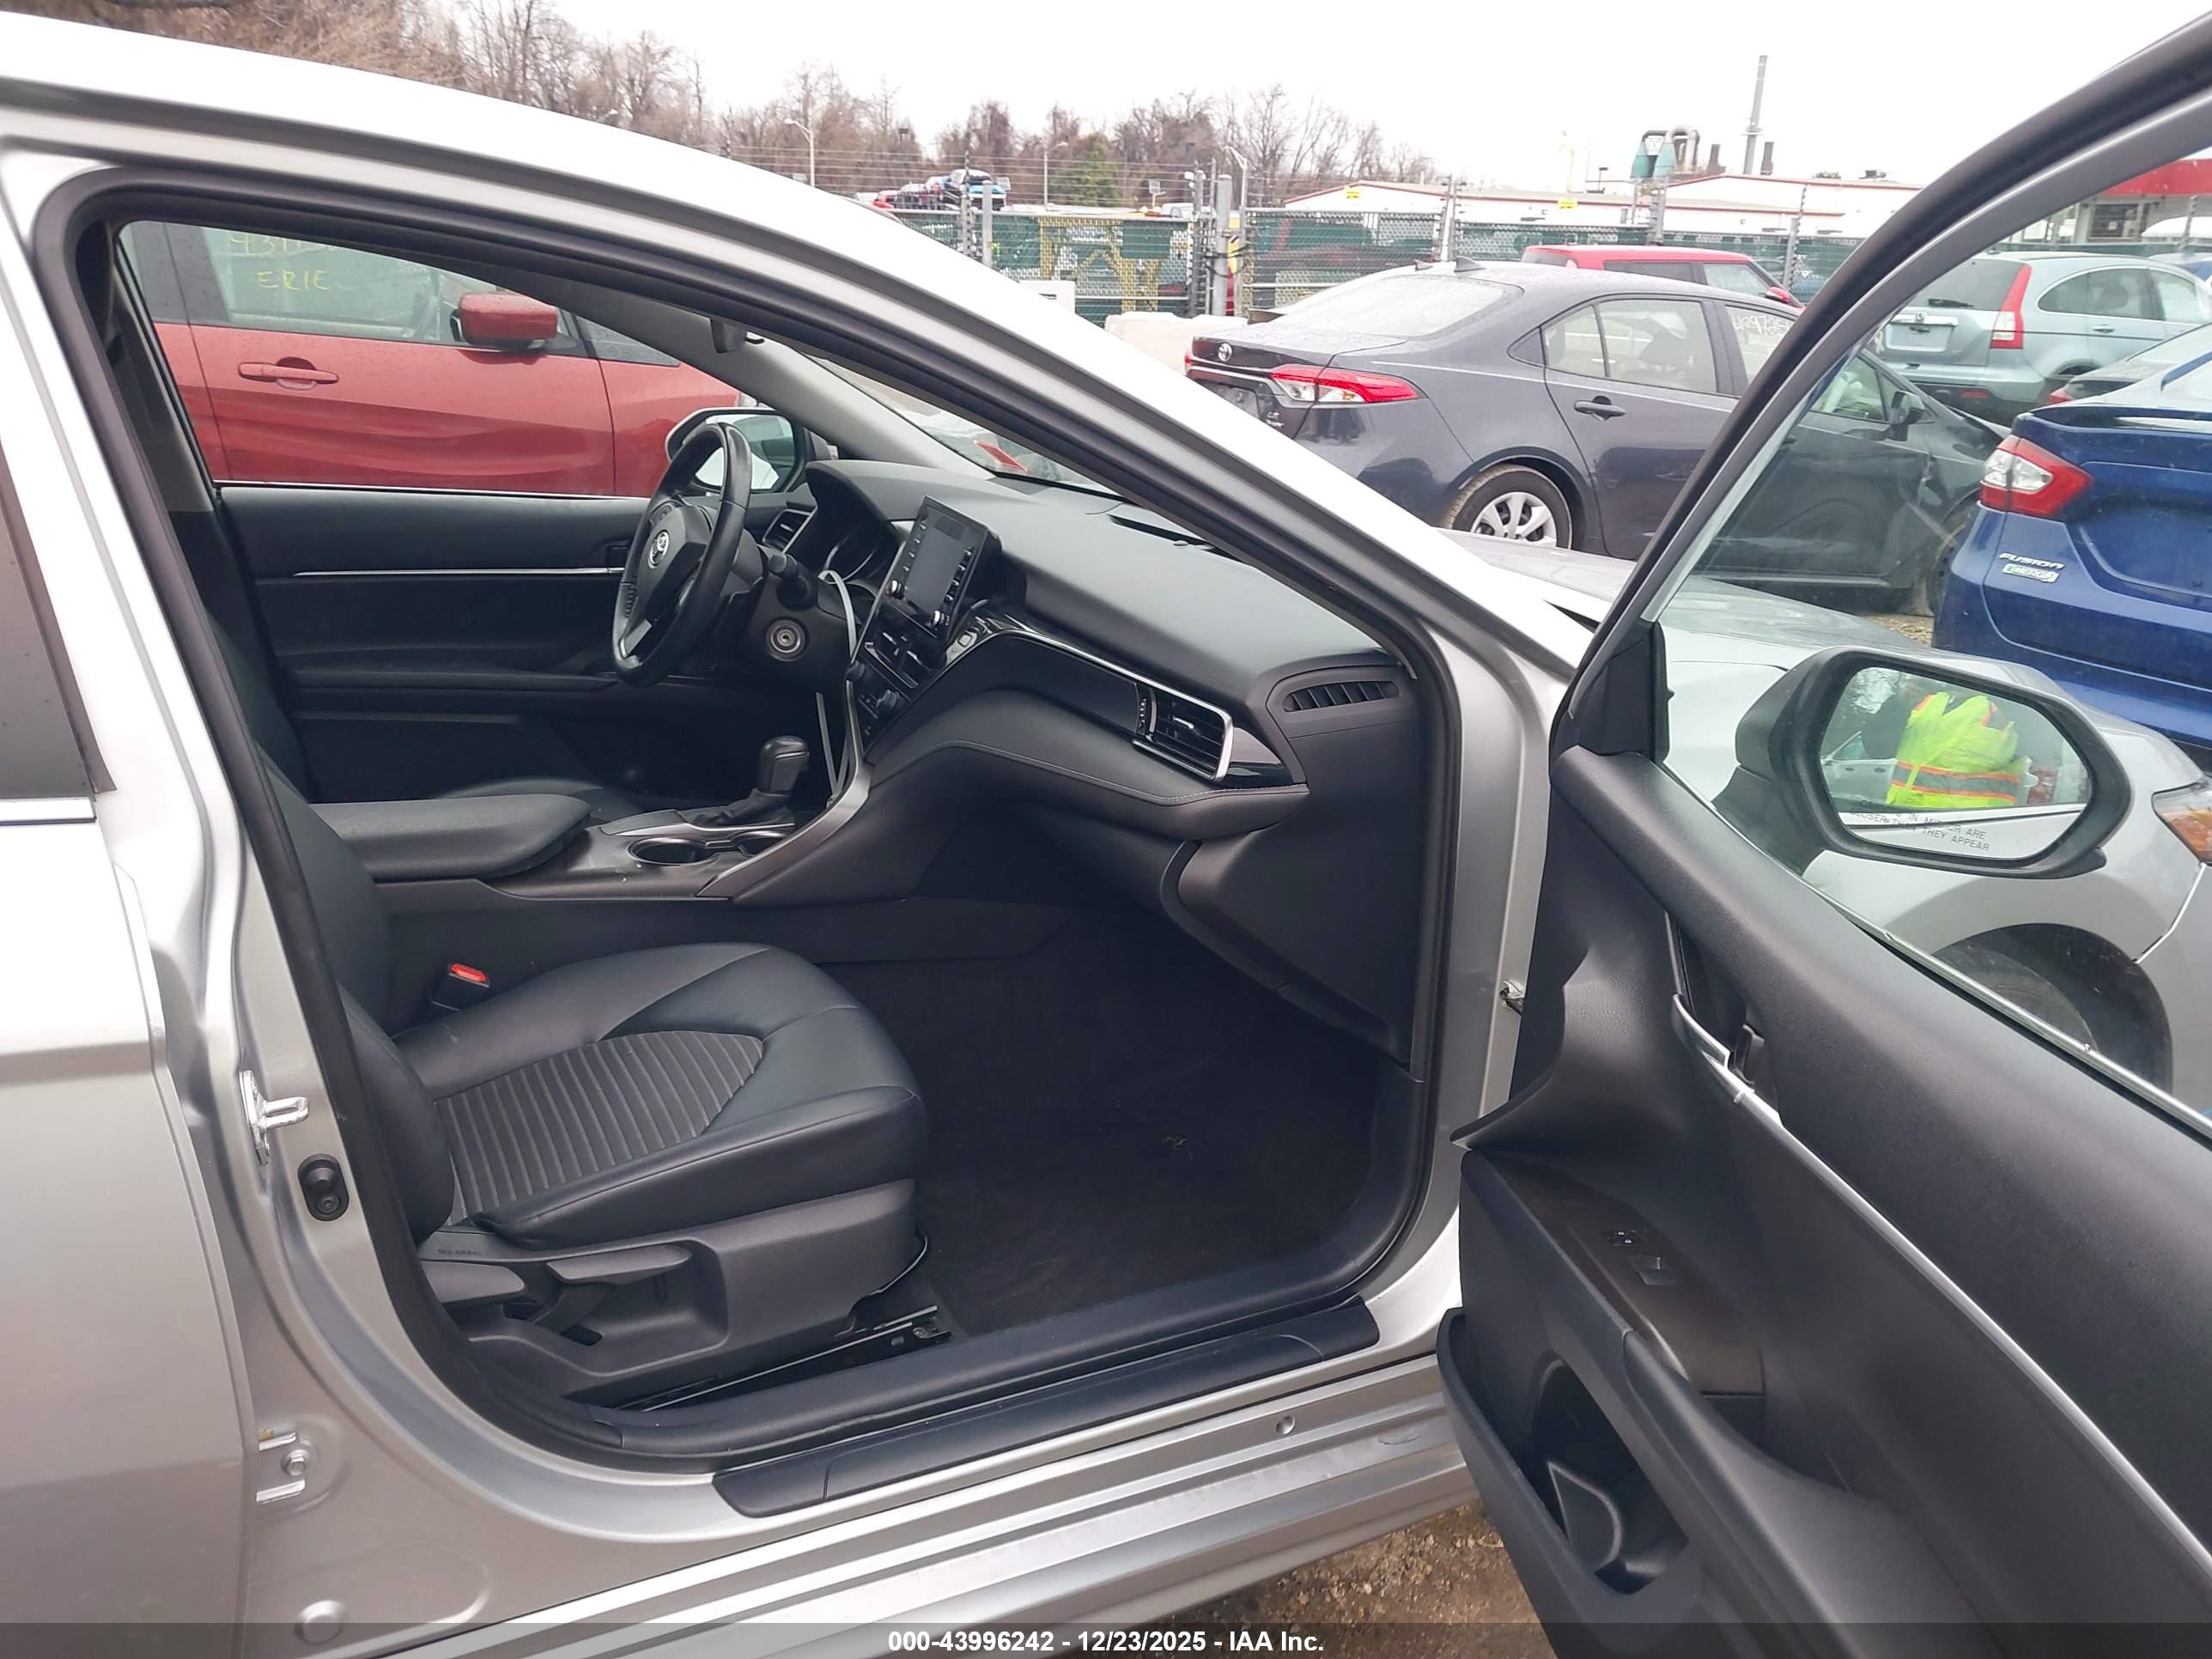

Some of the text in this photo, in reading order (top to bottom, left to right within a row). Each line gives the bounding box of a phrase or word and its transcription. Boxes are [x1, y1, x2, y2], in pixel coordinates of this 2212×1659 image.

[258, 270, 330, 290] ERIE
[1998, 552, 2065, 570] FUSION
[1922, 827, 1947, 839] THEY
[1950, 835, 1990, 851] APPEAR
[1966, 827, 1986, 840] ARE
